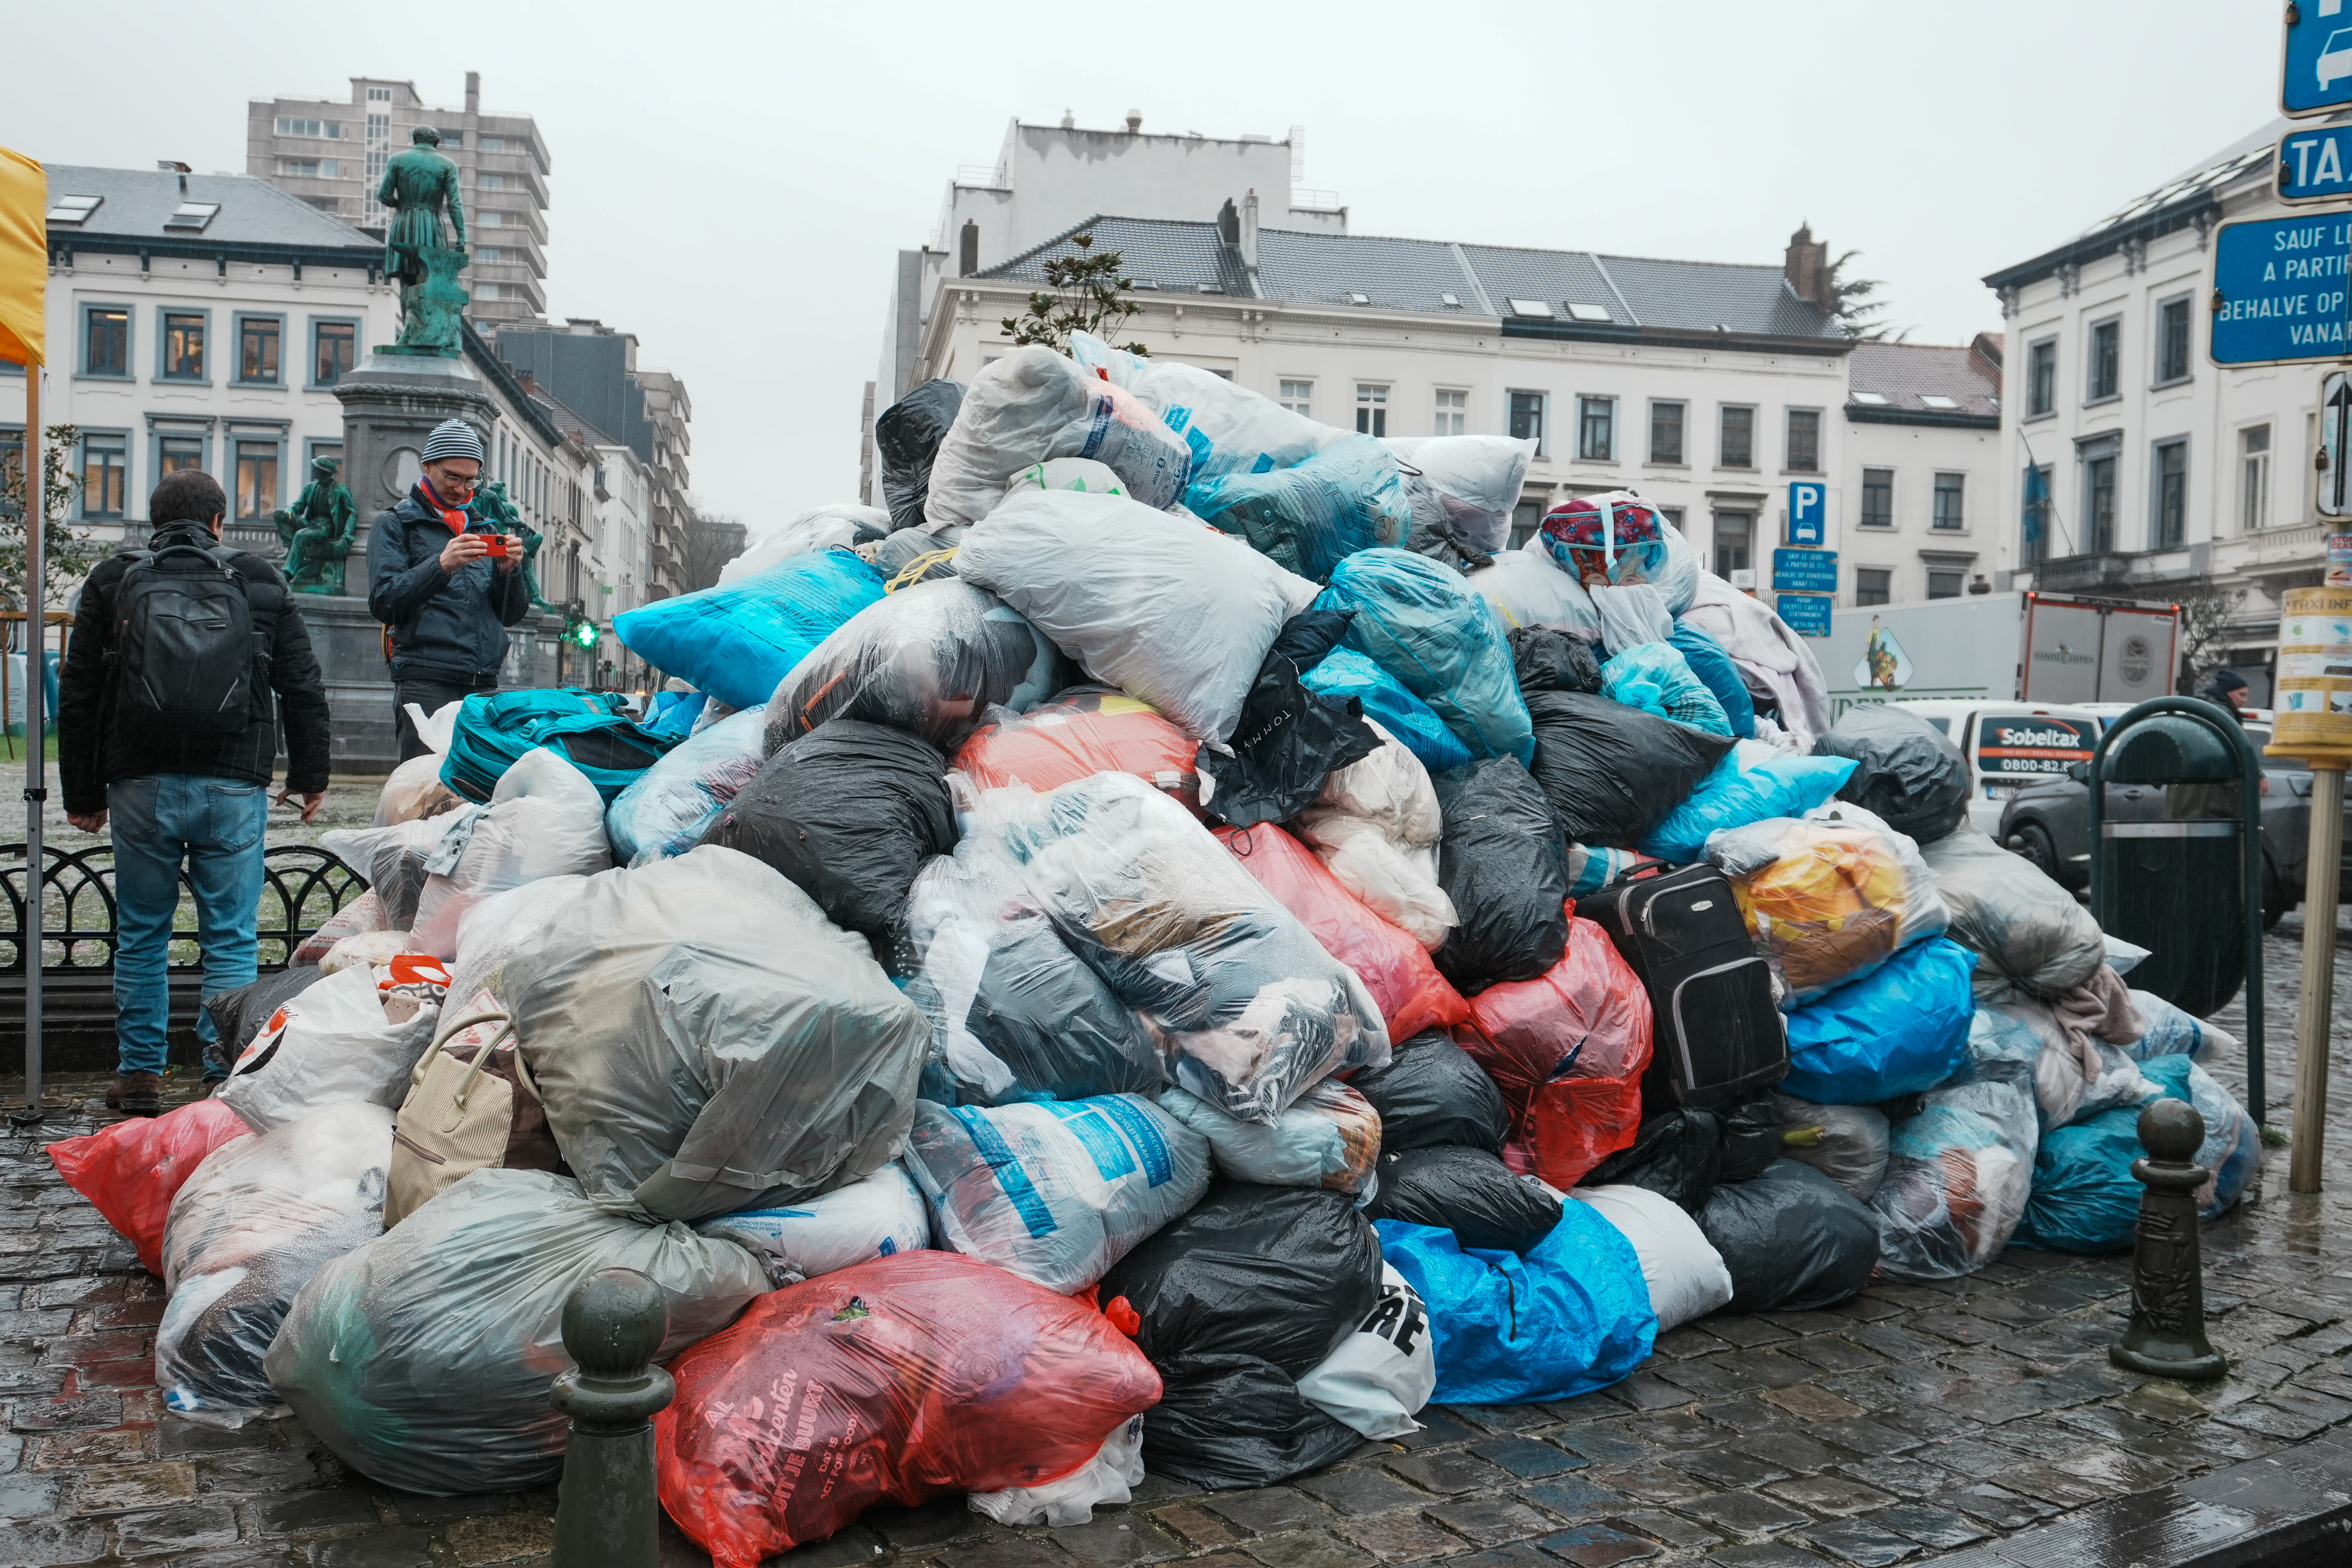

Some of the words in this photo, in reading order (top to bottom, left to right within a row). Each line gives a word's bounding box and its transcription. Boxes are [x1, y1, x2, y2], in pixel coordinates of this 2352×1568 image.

[2290, 137, 2352, 187] TA
[2275, 227, 2326, 251] SAUF
[2263, 262, 2276, 282] A
[2219, 294, 2309, 321] BEHALVE
[2317, 291, 2344, 313] OP
[1151, 469, 1161, 485] STOP
[1171, 477, 1178, 486] JA
[1283, 488, 1293, 501] Volume
[1305, 485, 1322, 507] OBLIGATOIRE
[1797, 487, 1818, 519] P
[2291, 599, 2324, 610] TAXI
[1244, 710, 1291, 748] TOMMY
[2002, 727, 2081, 748] Sobeltax
[1145, 1106, 1167, 1129] Brussels
[1136, 1117, 1150, 1131] NON
[1146, 1130, 1168, 1180] RECYCLABLES
[1141, 1107, 1170, 1146] Hoofdstedelijk
[1167, 1146, 1177, 1172] Gewest
[793, 1380, 825, 1451] BUURT
[784, 1453, 806, 1477] JE
[819, 1451, 832, 1473] DAT
[828, 1437, 838, 1447] IS
[831, 1453, 844, 1477] FOR
